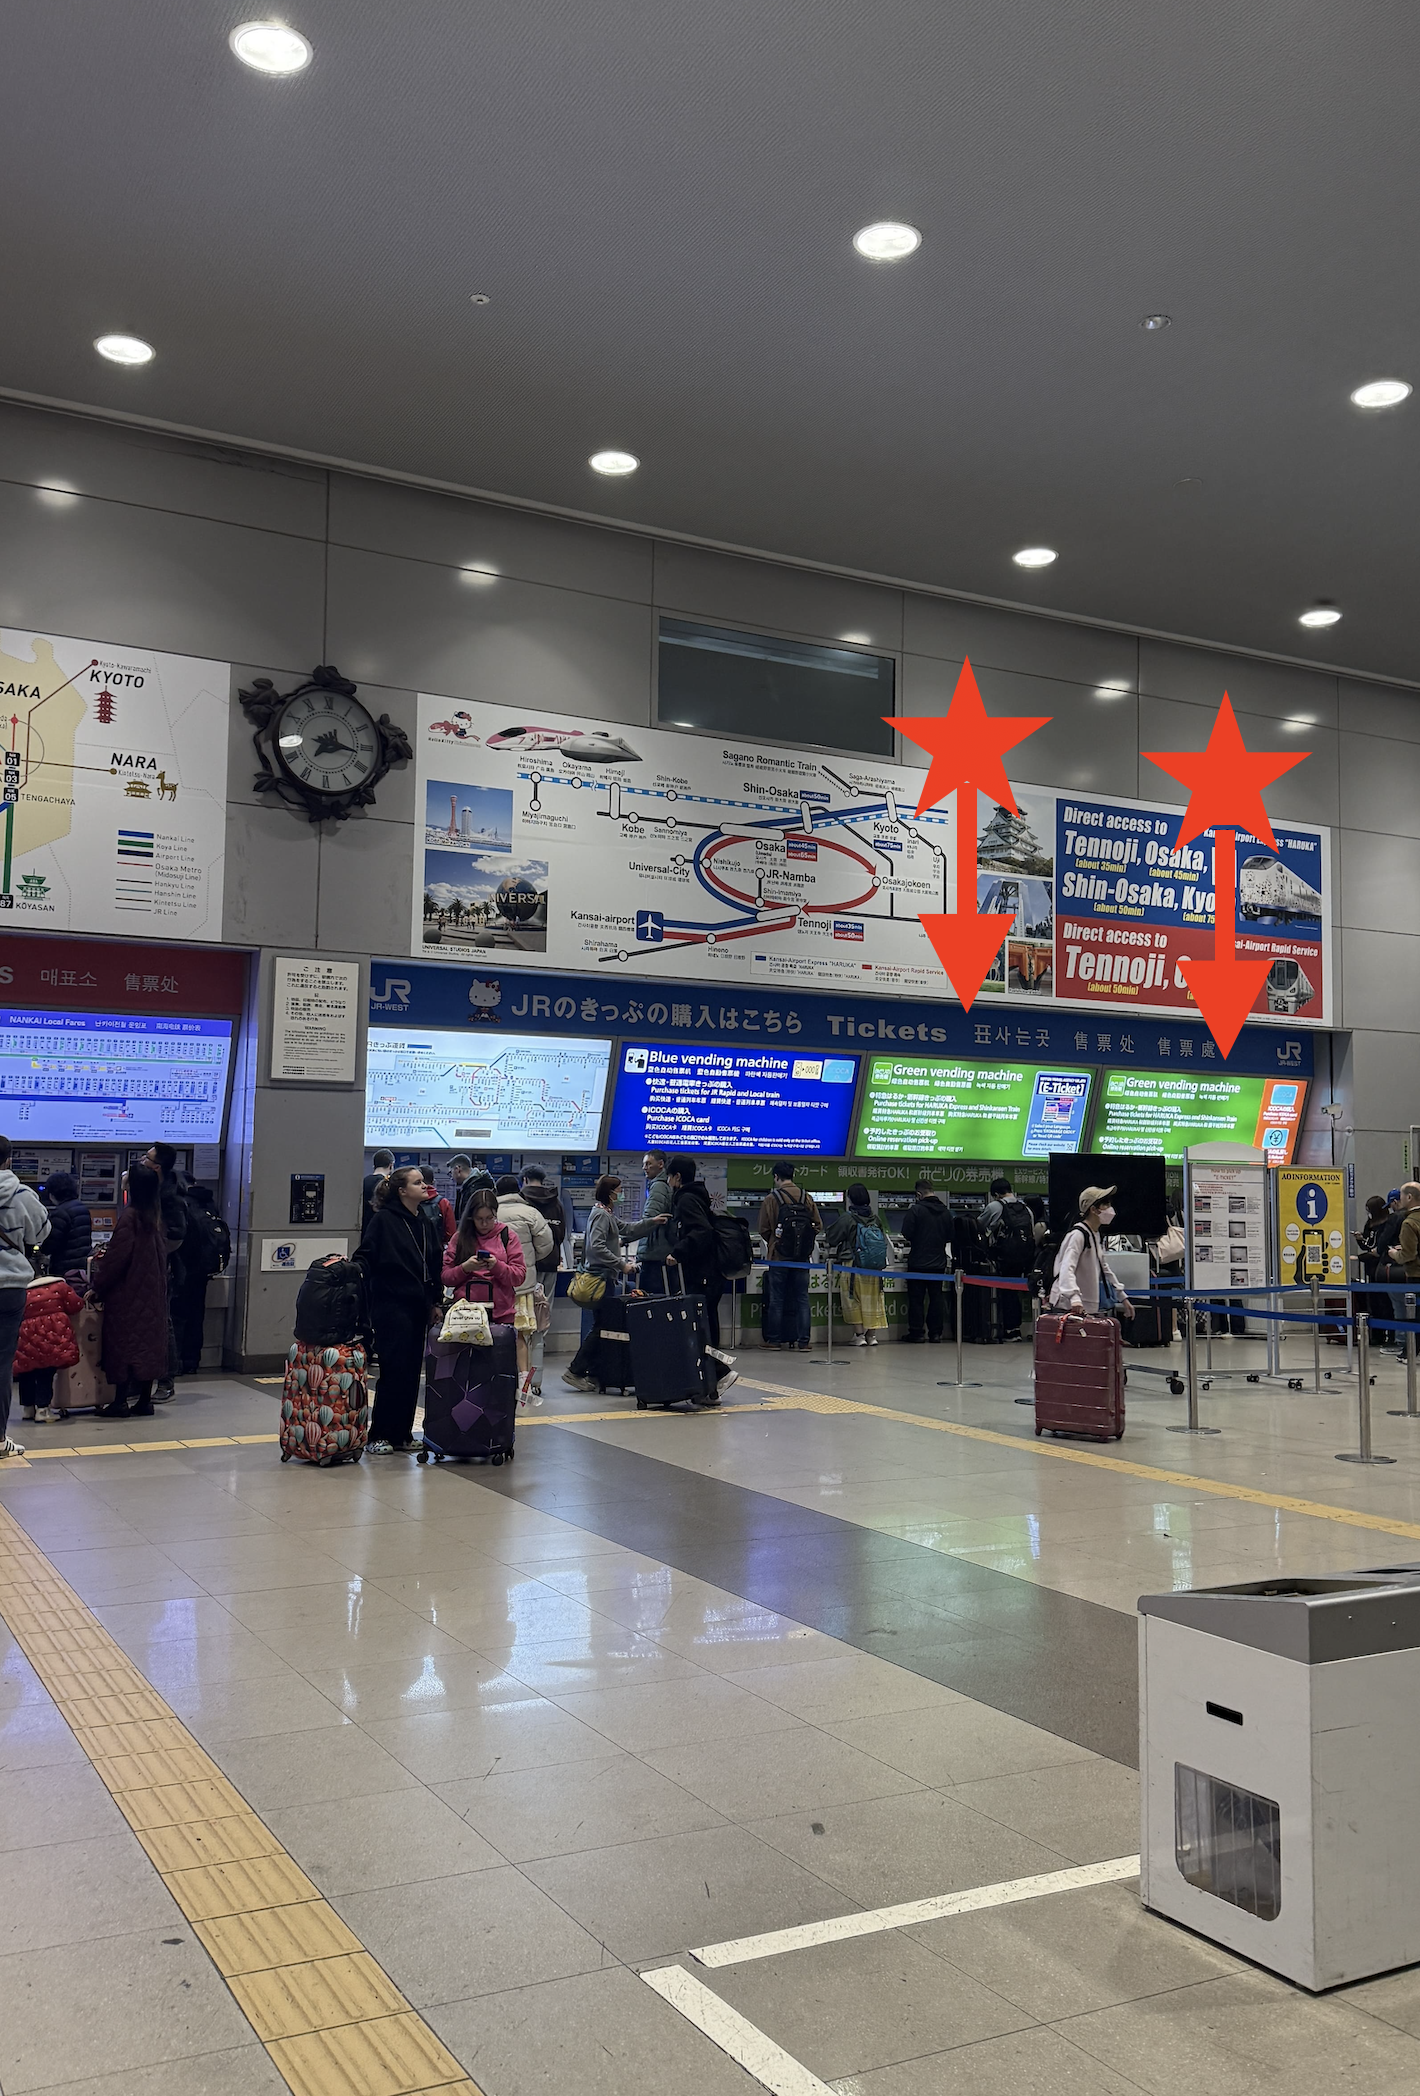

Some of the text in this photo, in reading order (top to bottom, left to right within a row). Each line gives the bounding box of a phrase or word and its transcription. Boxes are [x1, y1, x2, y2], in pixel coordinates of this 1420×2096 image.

[90, 670, 145, 688] KYOTO
[6, 758, 18, 766] 01
[111, 752, 157, 770] NARA
[520, 756, 552, 766] Hiroshima
[562, 762, 592, 772] Okayama
[722, 750, 755, 763] Sagano
[756, 755, 796, 768] Romantic
[797, 760, 818, 772] Train
[5, 775, 18, 783] 03
[606, 768, 626, 777] Himeji
[849, 773, 896, 785] Saga-Arashiyama
[656, 775, 688, 784] Shin-Kobe
[4, 792, 17, 801] 05
[743, 782, 799, 798] Shin-Osaka
[21, 794, 76, 806] TENGACHAYA
[522, 811, 568, 822] Miyajimaguchi
[1064, 806, 1168, 836] Direct access to
[622, 824, 644, 834] Kobe
[654, 826, 688, 836] Sannomiya
[874, 822, 900, 834] Kyoto
[156, 834, 180, 842] Nankai
[156, 844, 173, 852] Koya
[756, 840, 786, 852] Osaka
[1064, 830, 1208, 874] Tennoji, Osaka,
[155, 853, 180, 862] Airport
[714, 858, 740, 868] Nishikujo
[155, 863, 202, 874] Osaka Metro
[628, 862, 690, 878] Universal-City
[1075, 858, 1127, 874] (about 35min)
[155, 871, 202, 882] (Midosuji Line)
[766, 869, 816, 884] JR-Namba
[1149, 867, 1199, 882] (about 45min)
[155, 880, 180, 890] Hankyu
[882, 876, 930, 889] Osakajokoen
[155, 890, 181, 898] Hanshin
[764, 888, 802, 898] Shin-Imamiya
[1062, 871, 1217, 914] Shin-Osaka, Kyo
[154, 899, 182, 908] Kintetsu
[1094, 902, 1145, 917] (about 50min)
[570, 910, 635, 925] Kansai-airport
[798, 917, 832, 930] Tennoji
[1182, 912, 1206, 923] (about
[1063, 922, 1168, 948] Direct access to
[584, 939, 618, 948] Shirahama
[1272, 943, 1318, 957] Rapid Service
[769, 956, 806, 965] Kansai-Airport
[1066, 944, 1168, 990] Tennoji,
[875, 965, 910, 974] Kansai-Airport
[910, 968, 926, 976] Rapid
[40, 969, 98, 987] 매표소
[124, 973, 178, 994] 售票处
[370, 978, 412, 1004] JR
[1088, 982, 1139, 996] (about 50min)
[512, 994, 803, 1034] JRのきっぷの購入はこちら
[10, 1015, 86, 1027] NANKAI Local Fares
[826, 1015, 948, 1043] Tickets
[974, 1024, 1050, 1048] 표사는곳
[1074, 1030, 1135, 1054] 售票处
[1277, 1042, 1302, 1060] JR
[650, 1051, 788, 1070] Blue vending machine
[894, 1064, 1024, 1082] Green vending machine
[1126, 1077, 1241, 1093] Green vending machine
[719, 1090, 736, 1098] Rapid
[753, 1164, 828, 1178] クレトカード
[919, 1166, 1004, 1182] みどりの券売機
